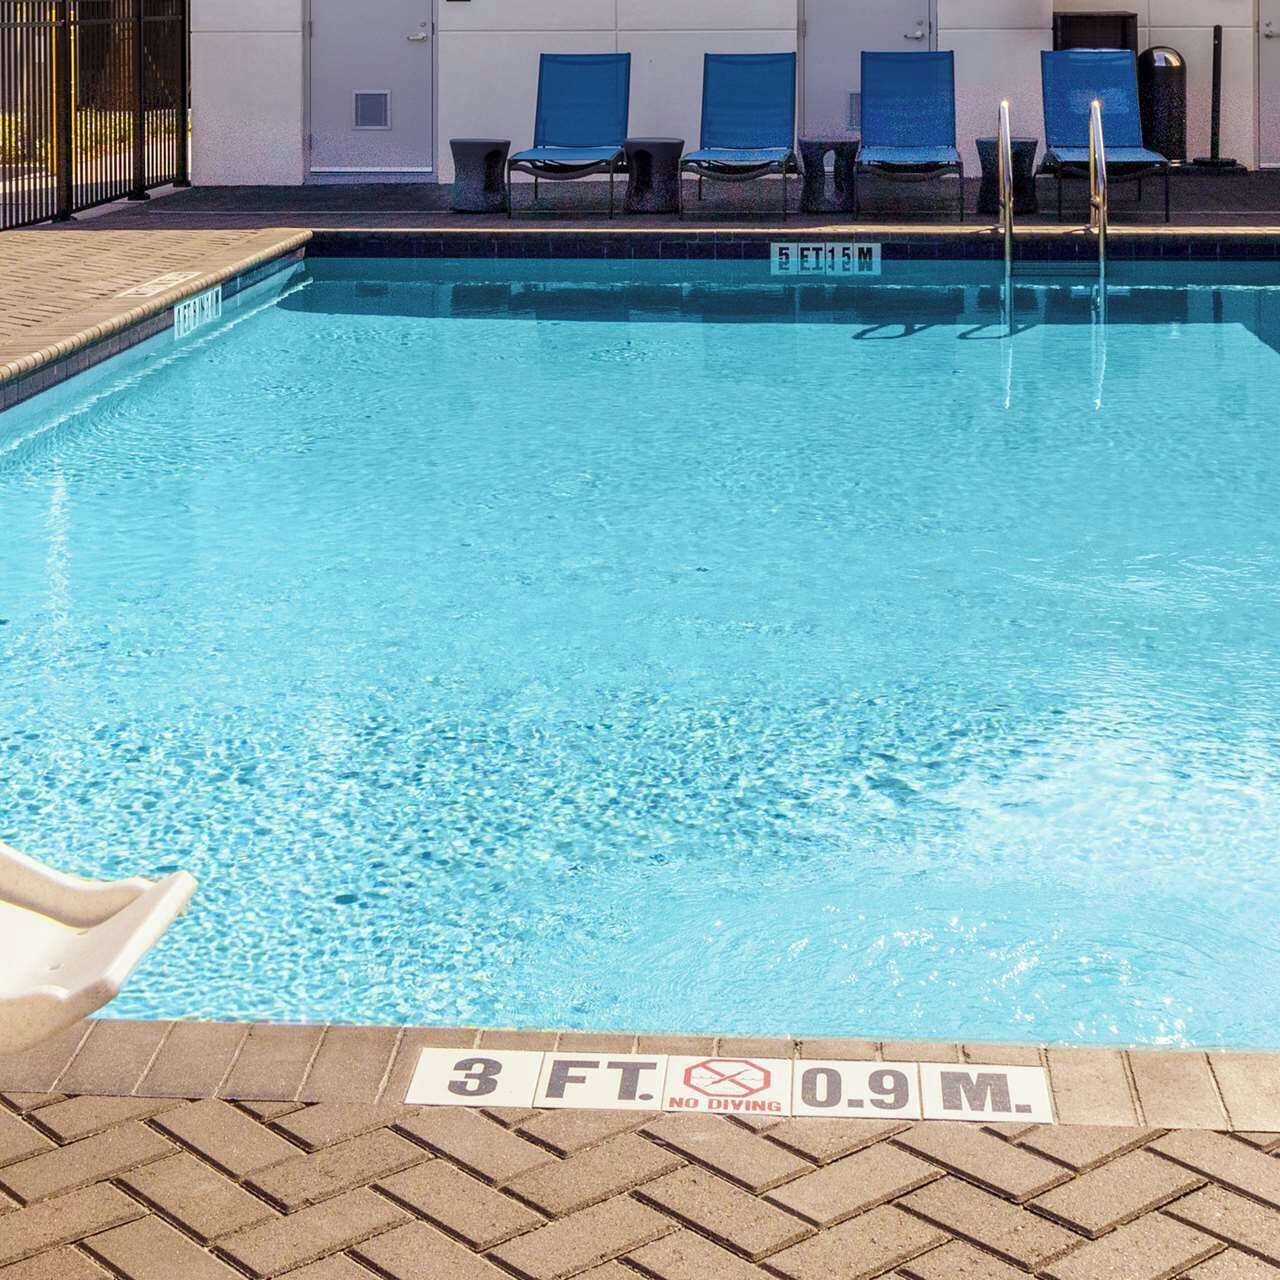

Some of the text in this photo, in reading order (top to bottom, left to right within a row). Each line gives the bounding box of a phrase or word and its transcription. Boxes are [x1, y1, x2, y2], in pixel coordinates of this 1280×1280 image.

[447, 1057, 1032, 1114] 3 FT. 0.9 M.
[668, 1097, 782, 1112] NO DIVING
